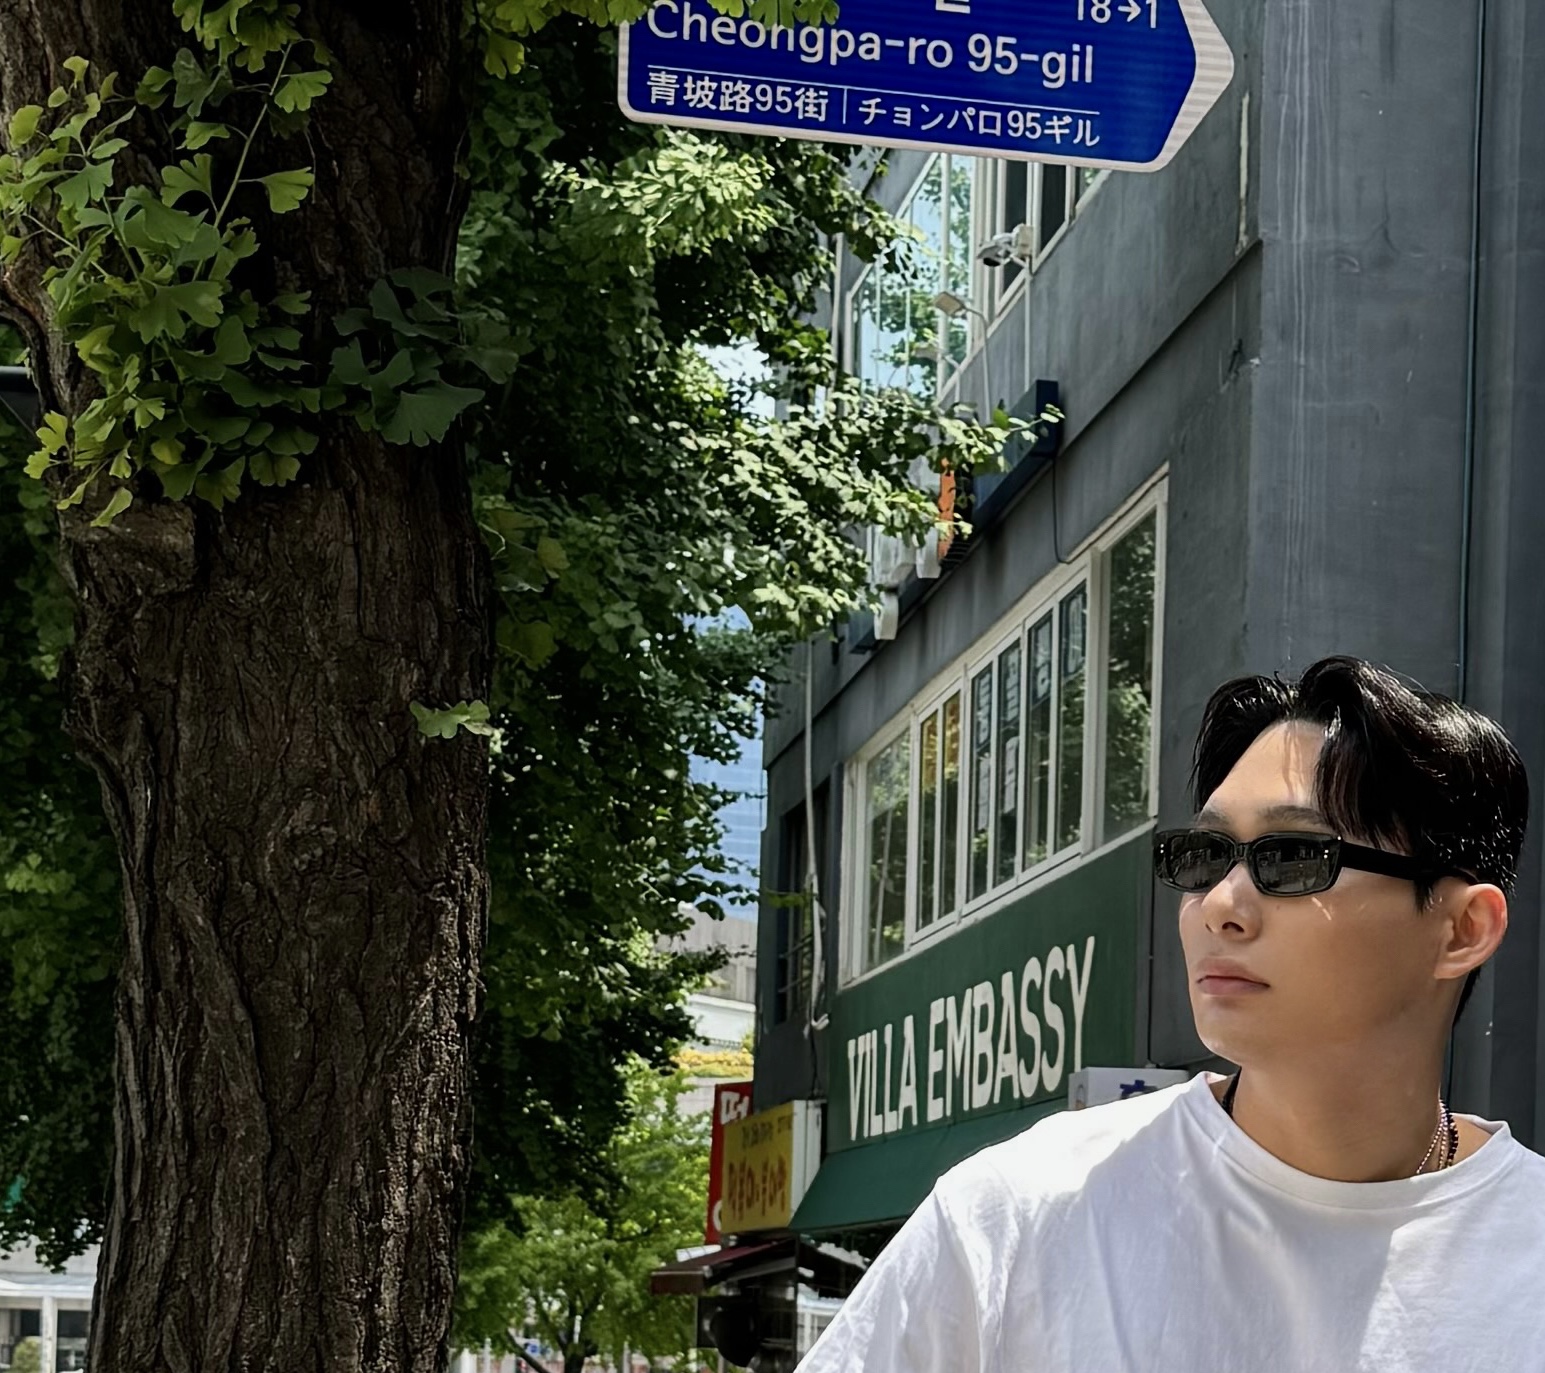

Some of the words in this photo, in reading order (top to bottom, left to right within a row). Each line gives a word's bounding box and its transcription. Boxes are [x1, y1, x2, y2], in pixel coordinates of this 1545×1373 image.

[647, 0, 954, 68] Cheongpa-ro
[967, 33, 1094, 89] 95-gil
[646, 70, 829, 122] 青坡路95街
[858, 97, 1100, 147] チョンパロ95ギル
[847, 1014, 918, 1142] VILLA
[926, 935, 1096, 1123] EMBASSY
